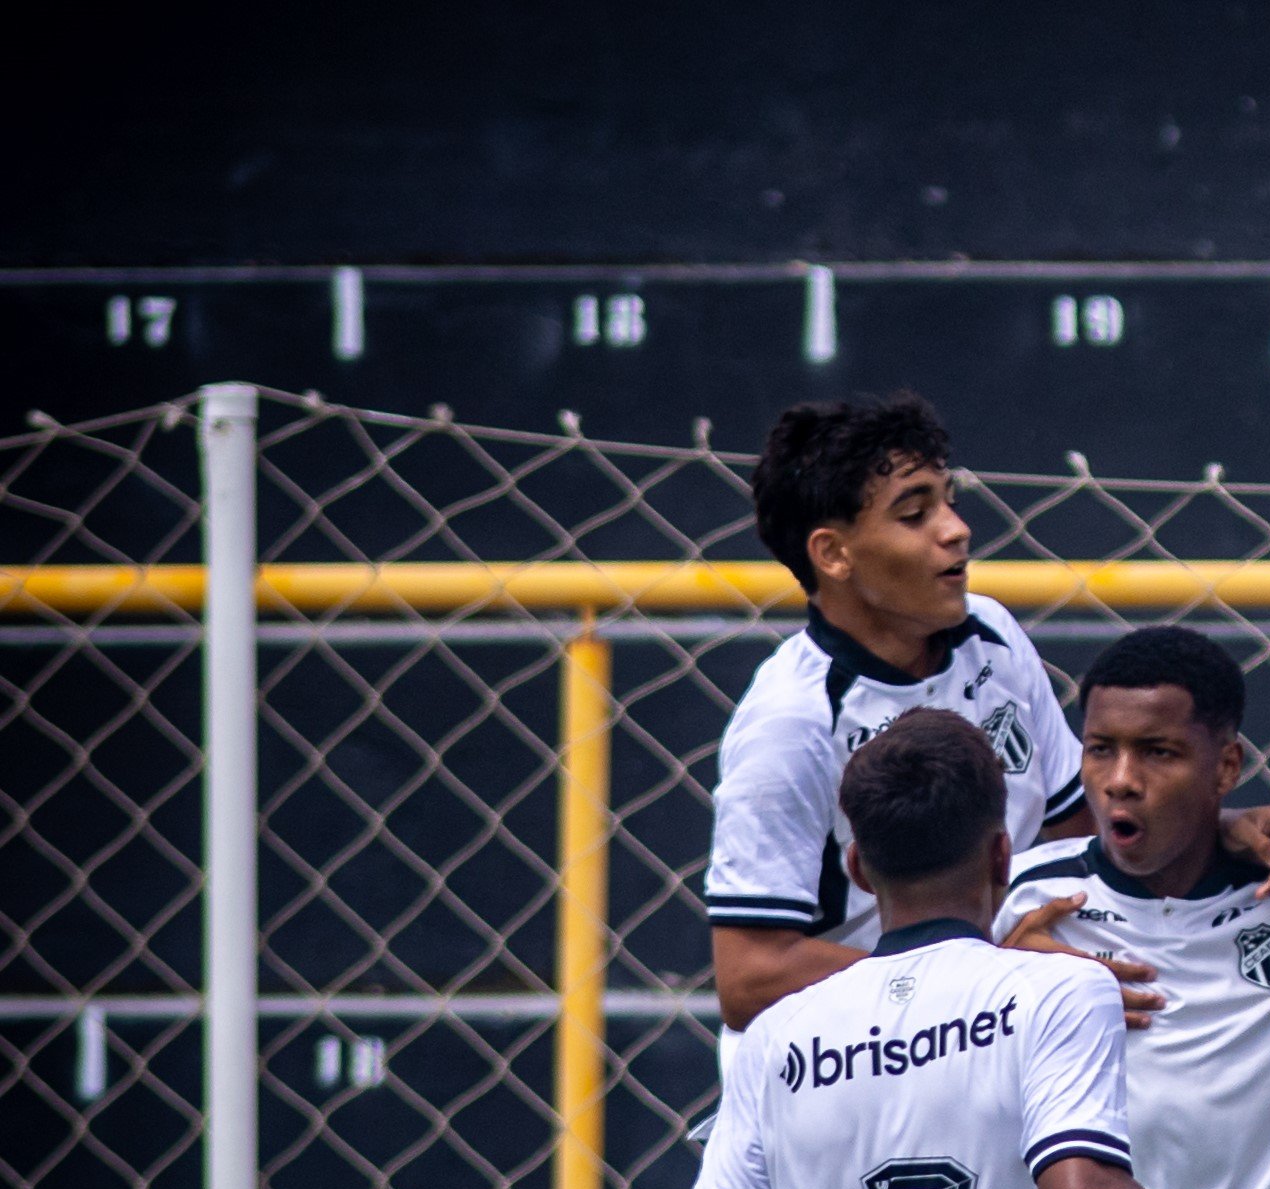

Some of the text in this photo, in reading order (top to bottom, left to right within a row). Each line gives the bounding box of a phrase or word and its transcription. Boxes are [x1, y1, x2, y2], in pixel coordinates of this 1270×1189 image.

[106, 294, 177, 348] 17
[573, 294, 646, 347] 18
[1051, 294, 1124, 347] 19
[813, 994, 1017, 1088] brisanet
